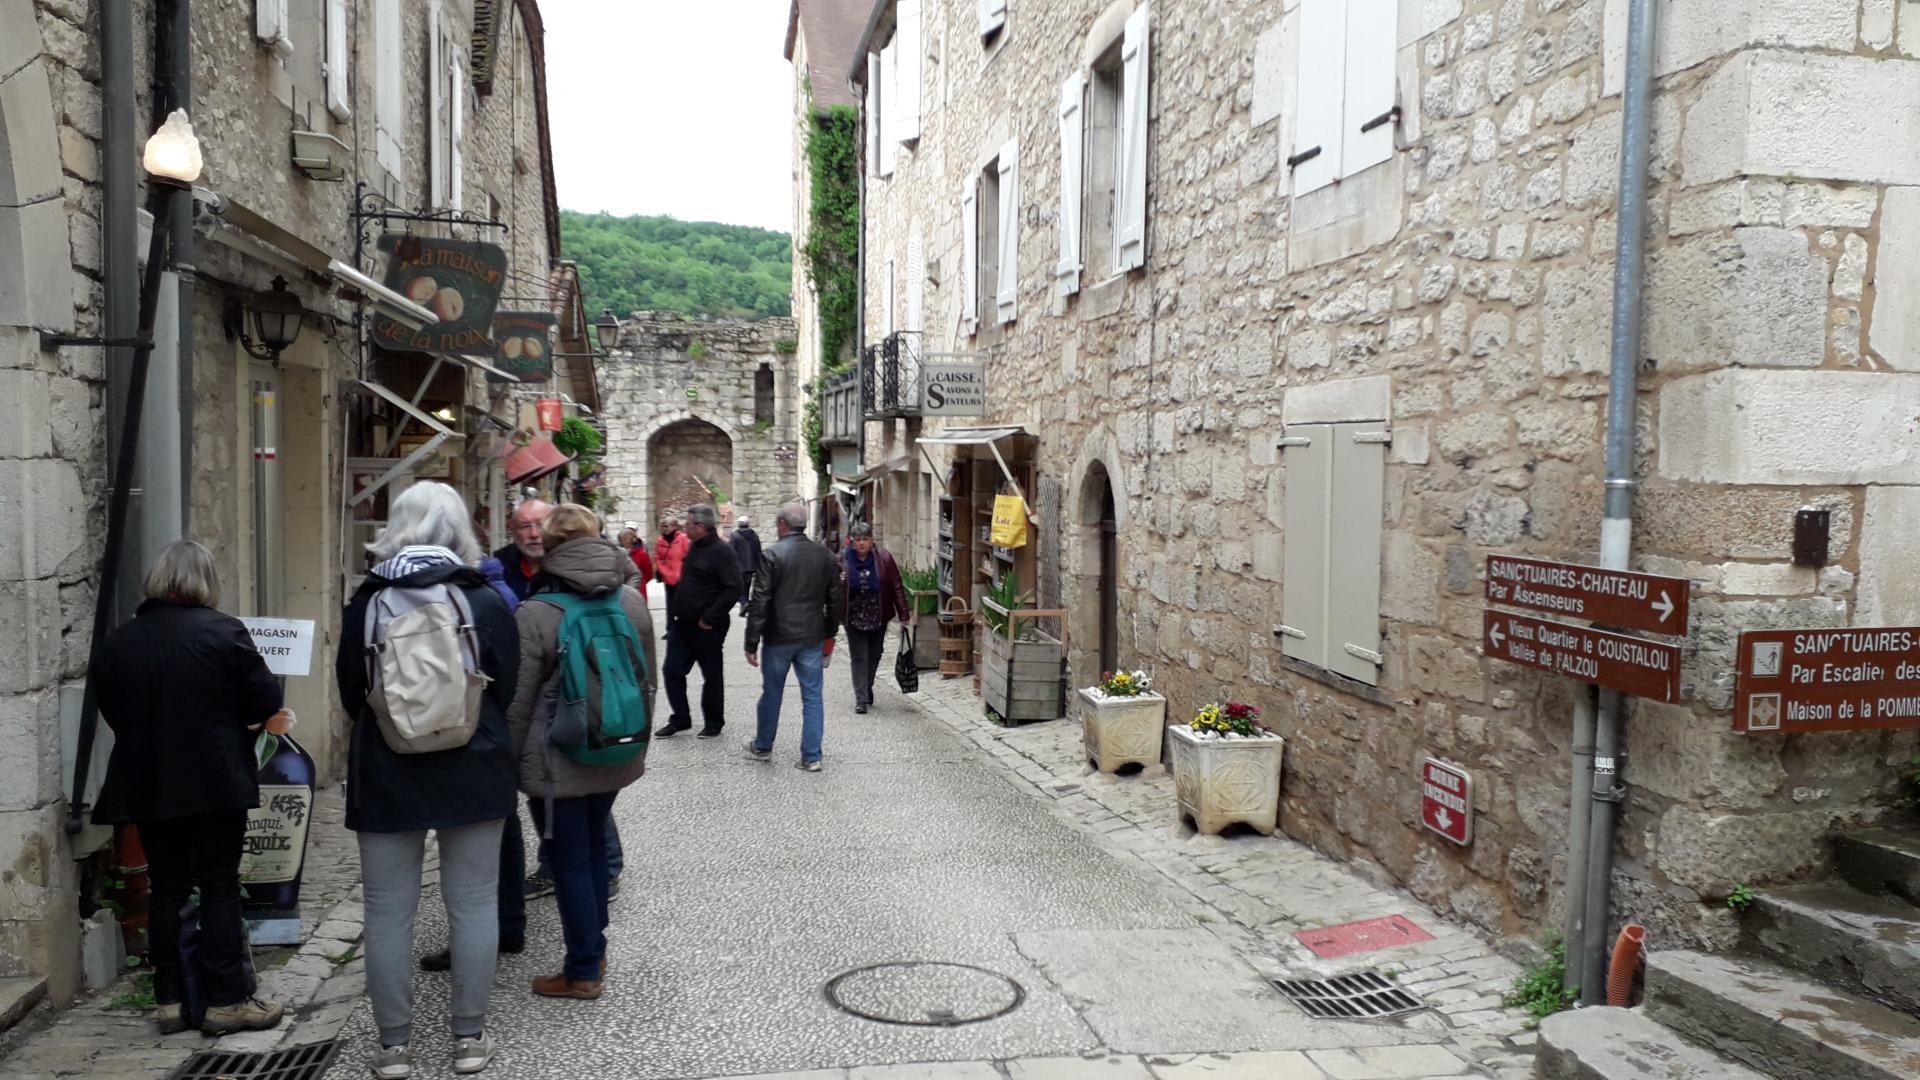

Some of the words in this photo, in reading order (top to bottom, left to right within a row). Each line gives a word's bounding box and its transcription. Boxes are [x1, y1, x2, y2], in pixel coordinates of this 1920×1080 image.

[436, 249, 502, 289] maison
[379, 320, 407, 342] de
[440, 326, 494, 350] noix
[936, 372, 976, 382] CAISSE
[1490, 560, 1648, 600] SANCTUAIRES-CHATEAU
[1488, 581, 1508, 599] Par
[1513, 585, 1584, 613] Ascenseurs
[249, 628, 298, 639] MAGASIN
[1794, 632, 1920, 654] SANCTUAIRES-
[258, 646, 291, 656] UVERT
[1508, 619, 1534, 641] Vieux
[1538, 625, 1579, 650] Quartier
[1583, 634, 1593, 654] le
[1598, 638, 1669, 671] COUSTALOU
[1508, 640, 1536, 662] Vallée
[1539, 649, 1552, 666] de
[1791, 664, 1816, 683] Par
[1896, 661, 1920, 681] des
[1787, 700, 1832, 720] Maison
[1839, 700, 1854, 719] de
[1860, 699, 1872, 718] la
[247, 817, 283, 833] inqui
